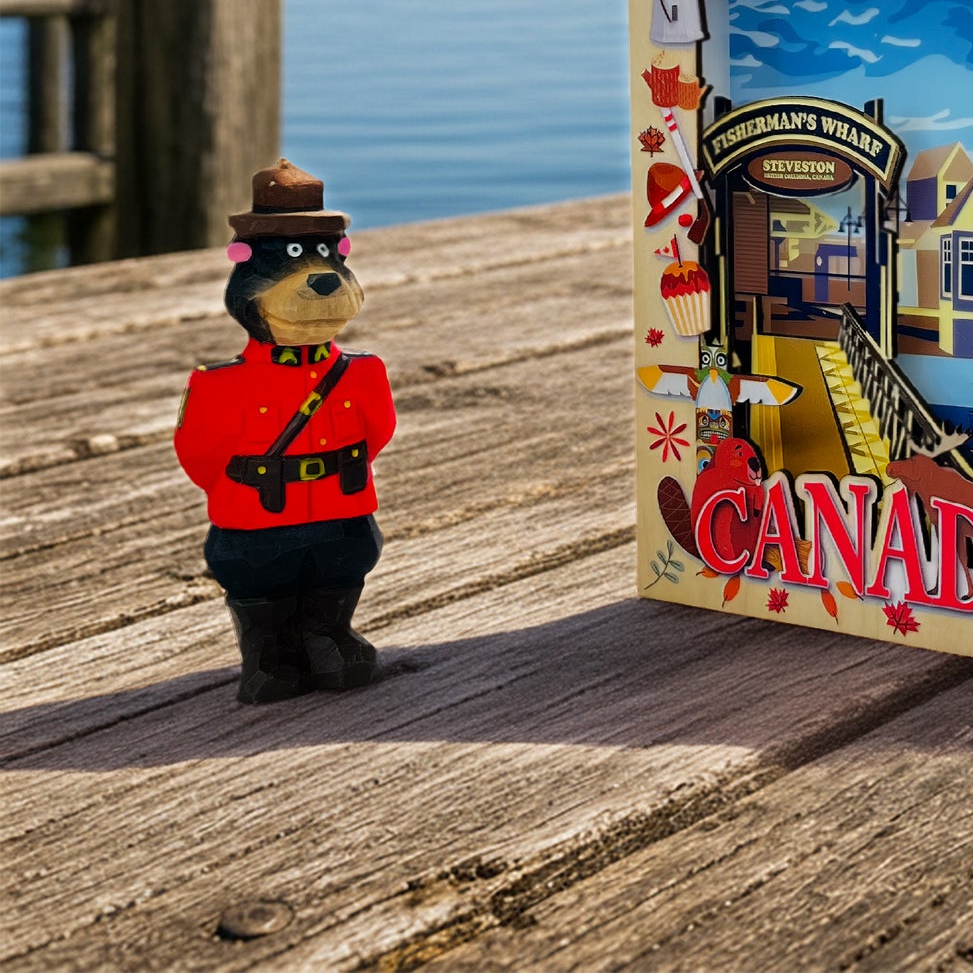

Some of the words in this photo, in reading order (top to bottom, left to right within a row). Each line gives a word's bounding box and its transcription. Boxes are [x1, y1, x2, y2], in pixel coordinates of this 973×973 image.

[712, 112, 816, 155] FISHERMAN'S
[821, 116, 883, 157] WHARF
[763, 159, 835, 173] STEVESTON
